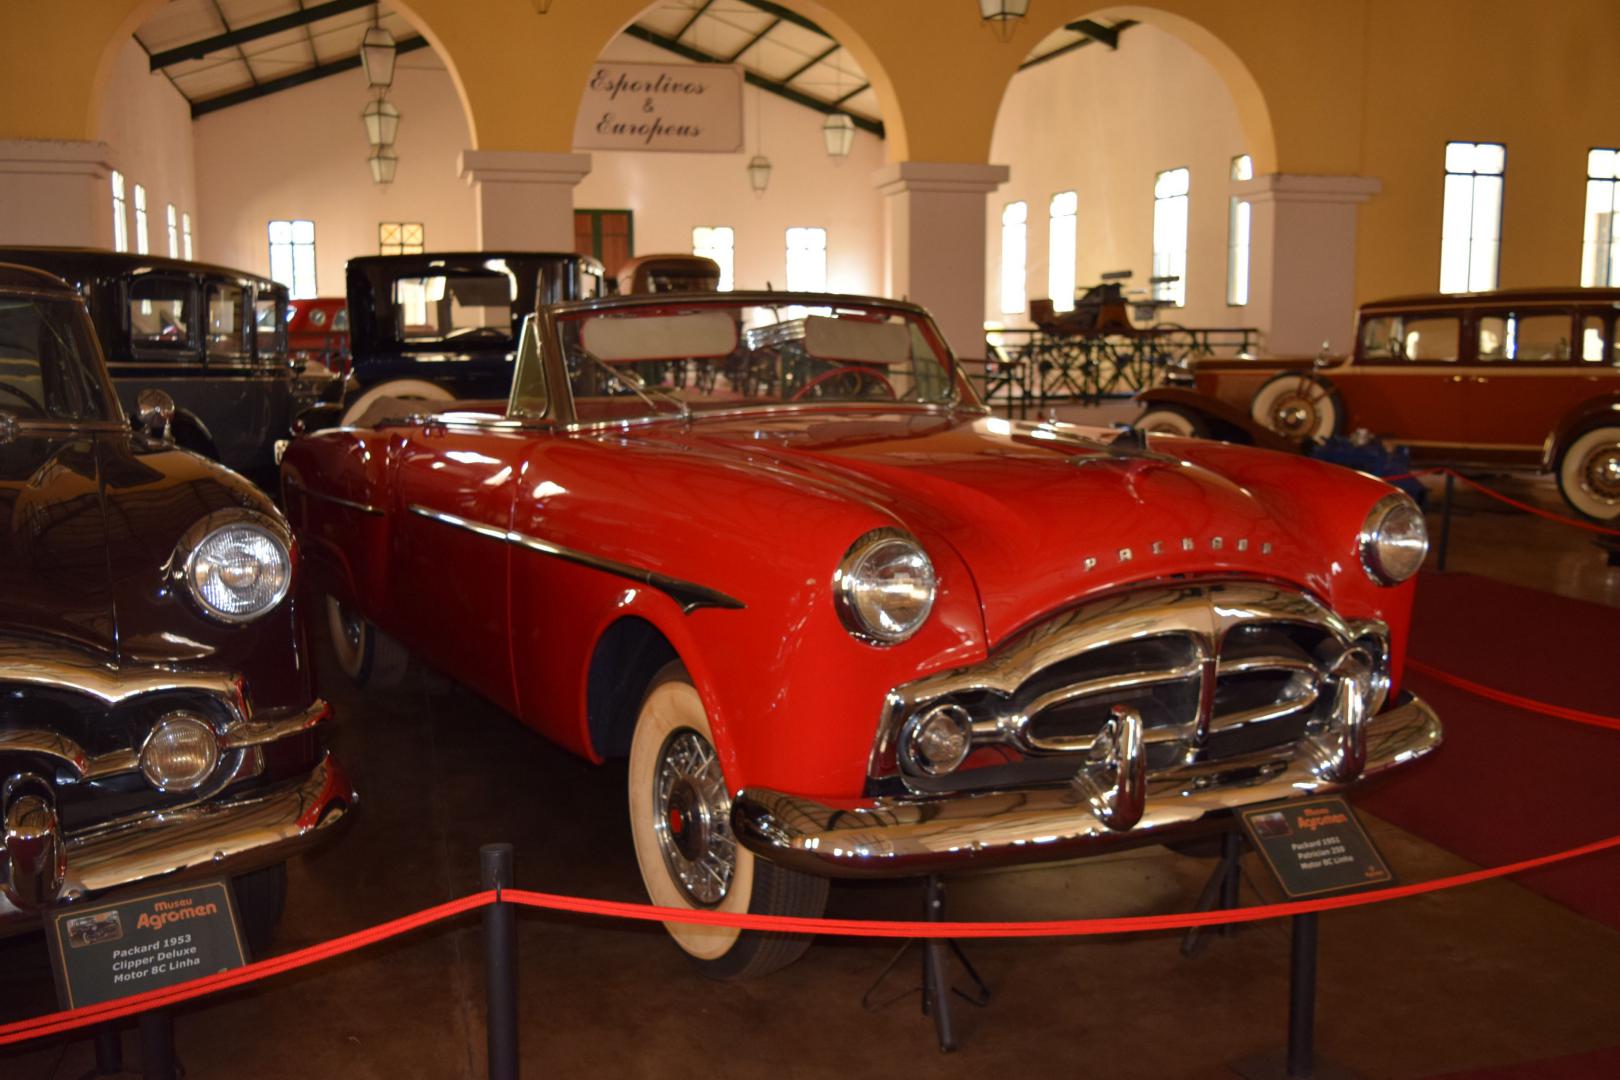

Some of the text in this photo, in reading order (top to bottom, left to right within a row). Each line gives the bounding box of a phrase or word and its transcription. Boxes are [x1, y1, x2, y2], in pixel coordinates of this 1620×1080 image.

[590, 69, 706, 100] Esportivos
[642, 97, 655, 114] &
[596, 112, 702, 145] Europeus
[136, 902, 218, 930] Agromen
[154, 898, 193, 912] Museu
[112, 934, 192, 959] Packard 1953
[112, 945, 197, 972] Clipper Deluxe
[113, 969, 149, 984] Motor
[168, 956, 201, 971] Linha
